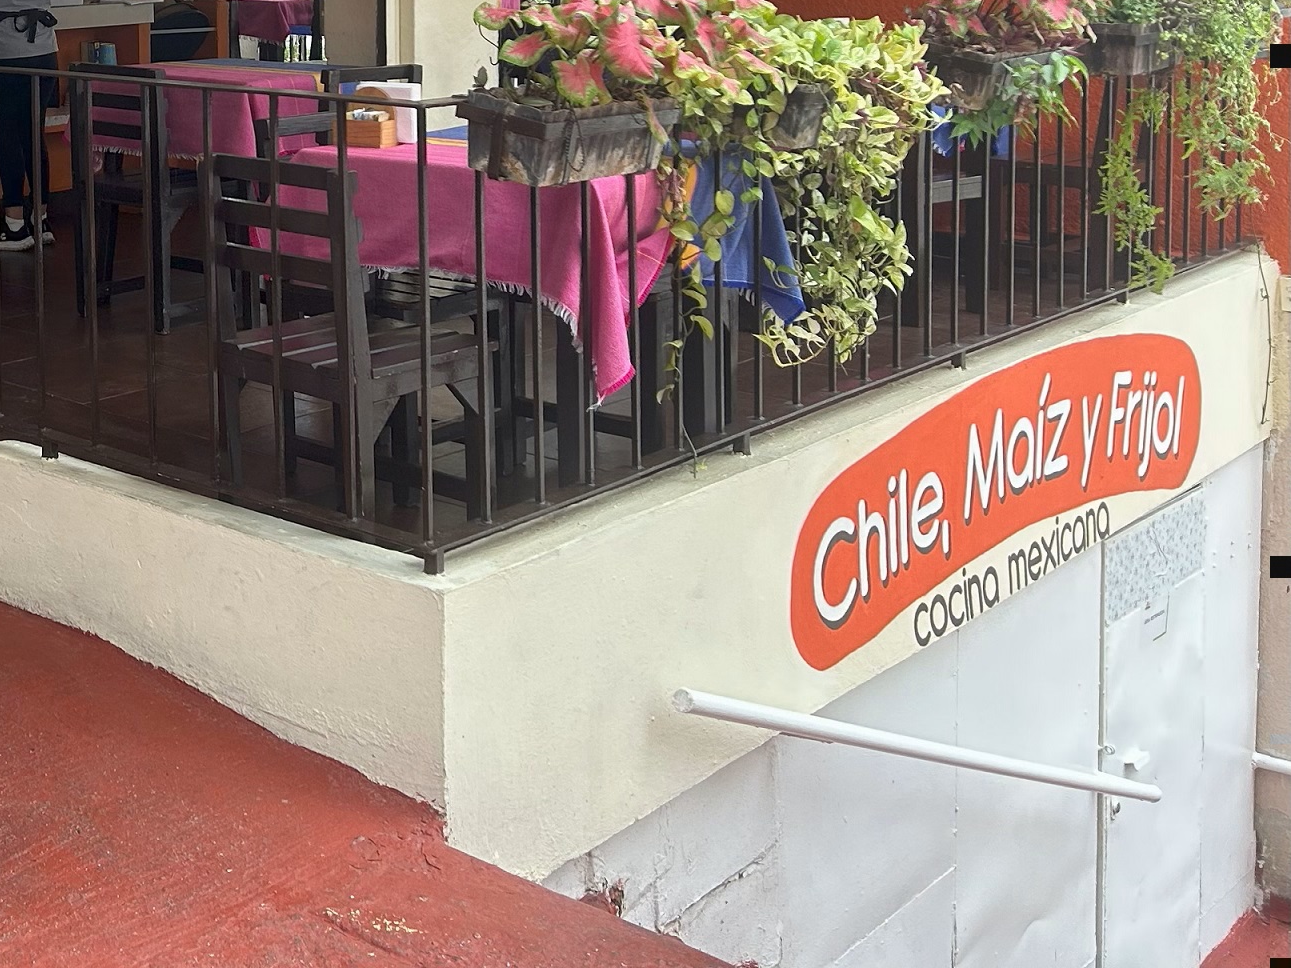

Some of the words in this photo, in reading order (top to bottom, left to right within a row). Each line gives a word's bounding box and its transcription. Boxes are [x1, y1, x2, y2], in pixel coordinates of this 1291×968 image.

[813, 468, 951, 629] Chile,
[964, 372, 1072, 524] Maíz
[1081, 393, 1103, 491] y
[1107, 370, 1186, 478] Frijol
[914, 566, 1000, 647] cocina
[1008, 501, 1111, 595] mexicana
